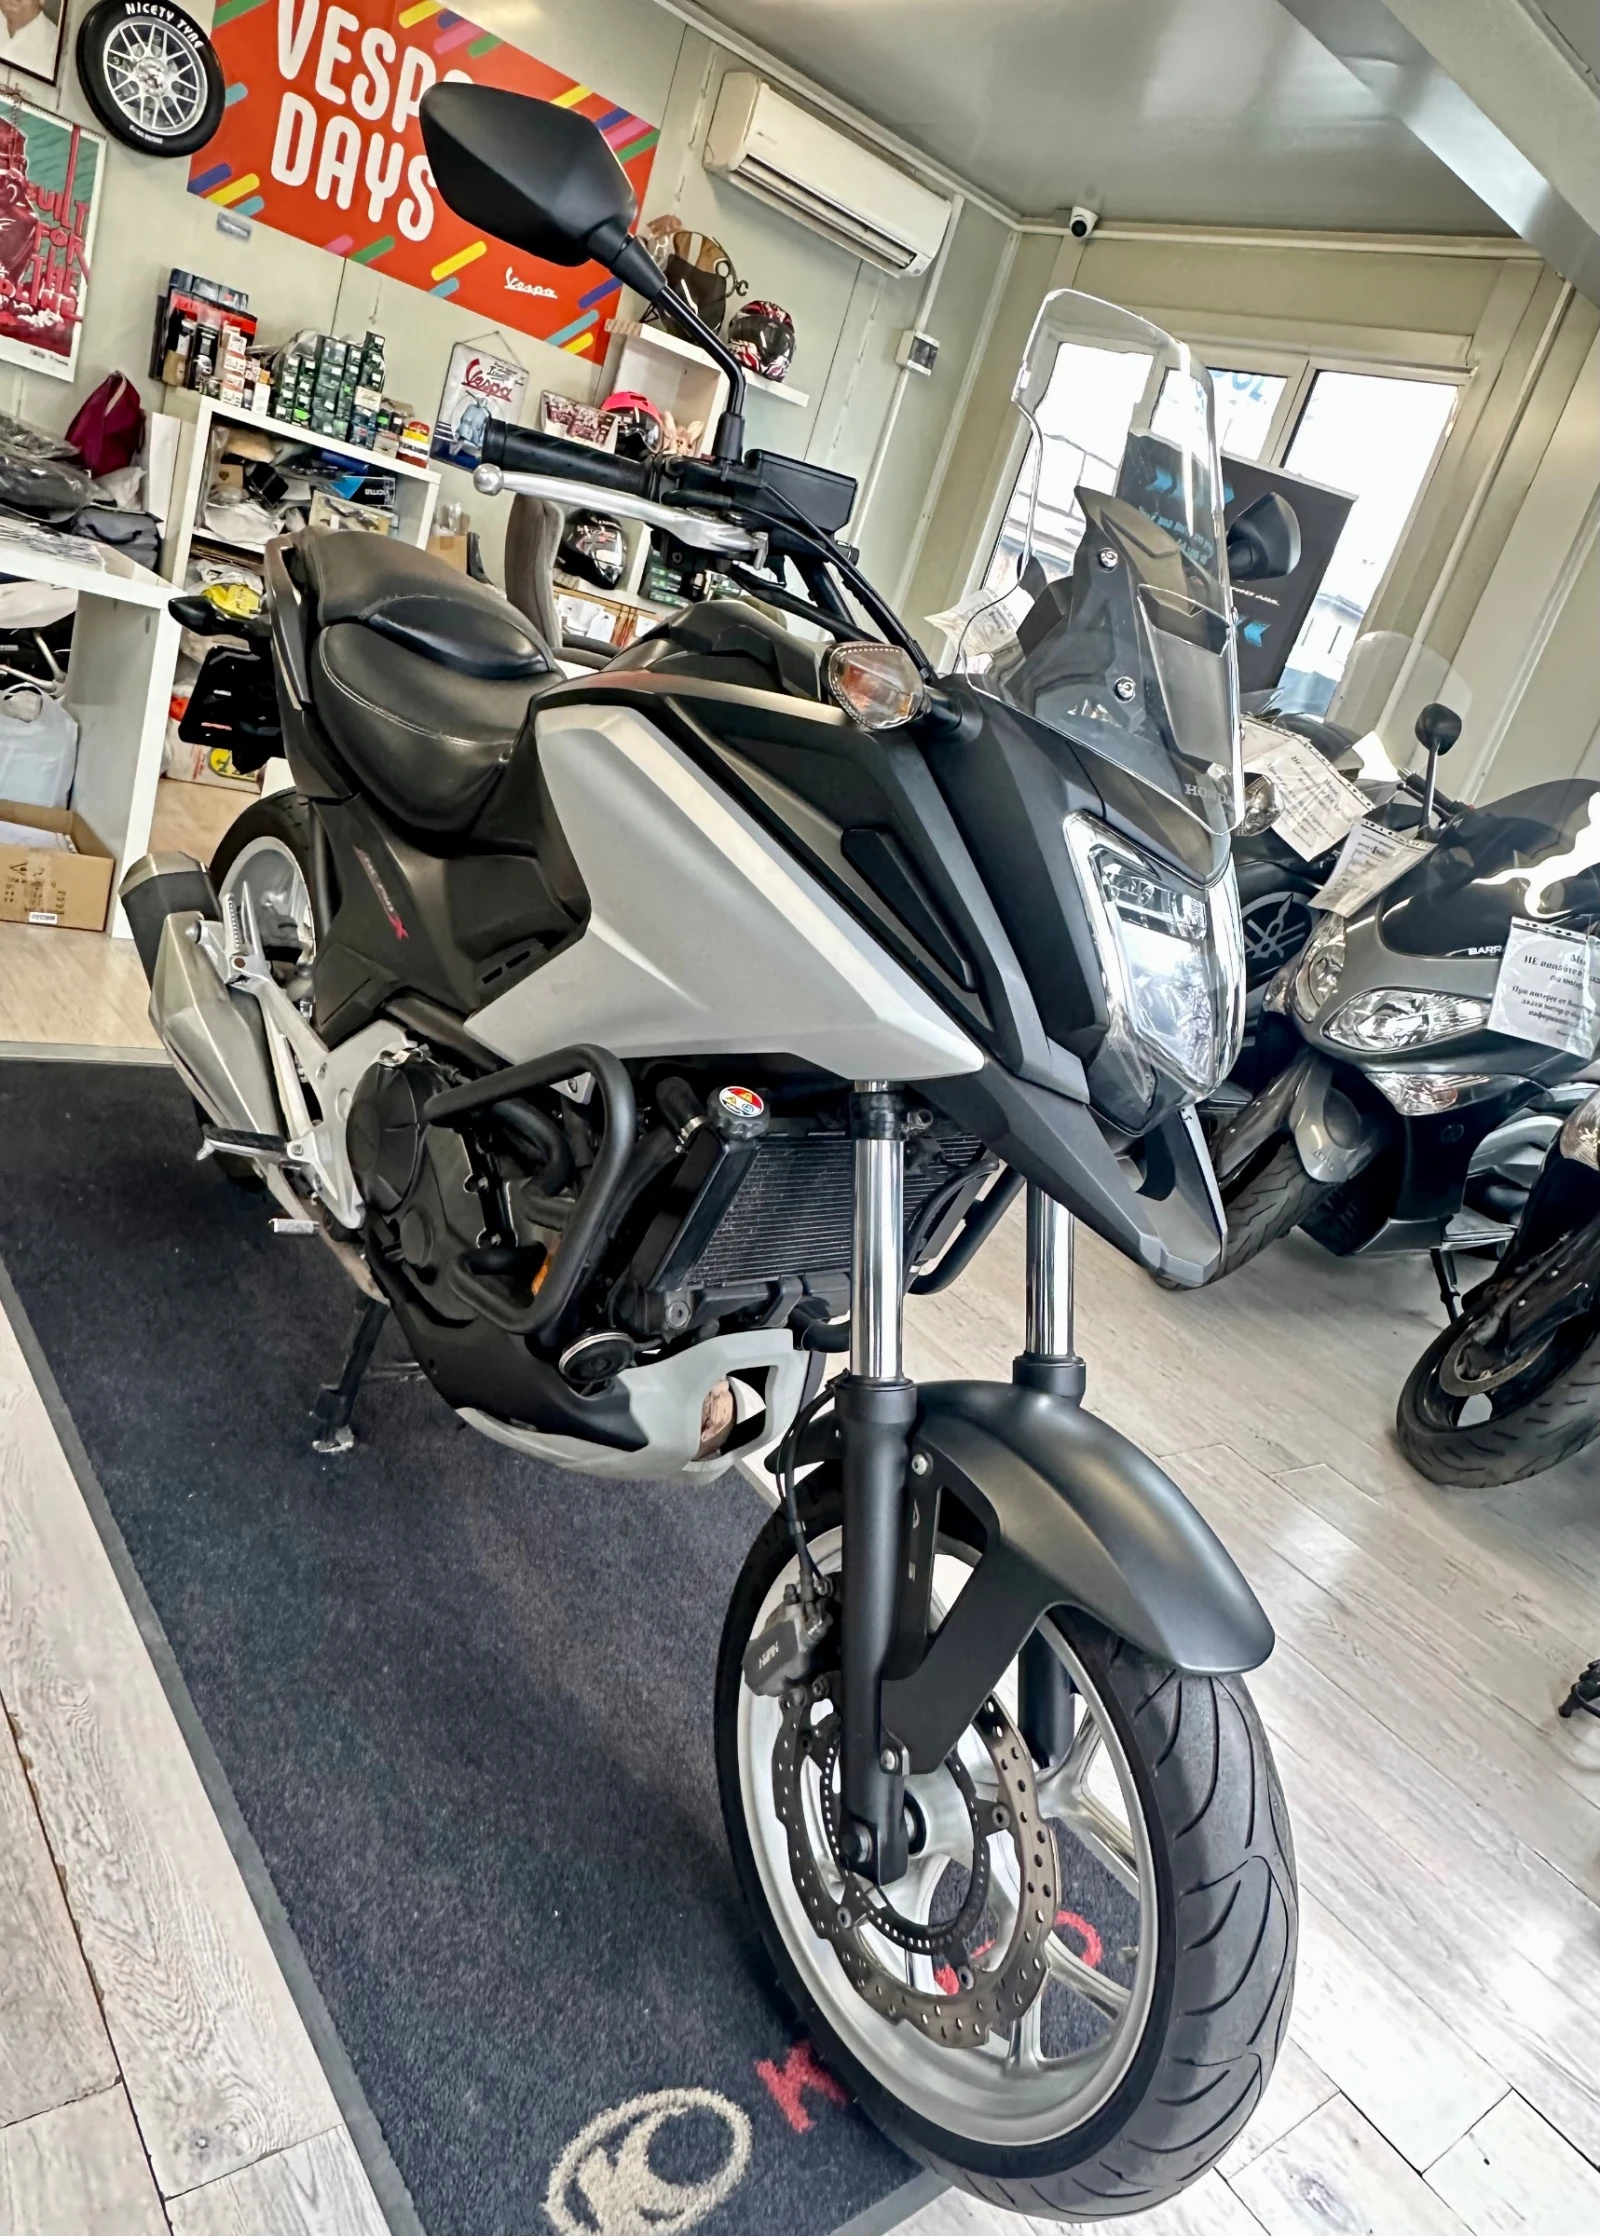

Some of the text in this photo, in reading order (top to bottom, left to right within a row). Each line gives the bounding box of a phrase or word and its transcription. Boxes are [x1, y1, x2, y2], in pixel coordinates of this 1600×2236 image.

[125, 2, 175, 22] NICETY
[278, 0, 474, 133] VESP
[271, 91, 438, 242] DAYS
[504, 266, 558, 300] Vespa
[461, 357, 512, 403] Vespa
